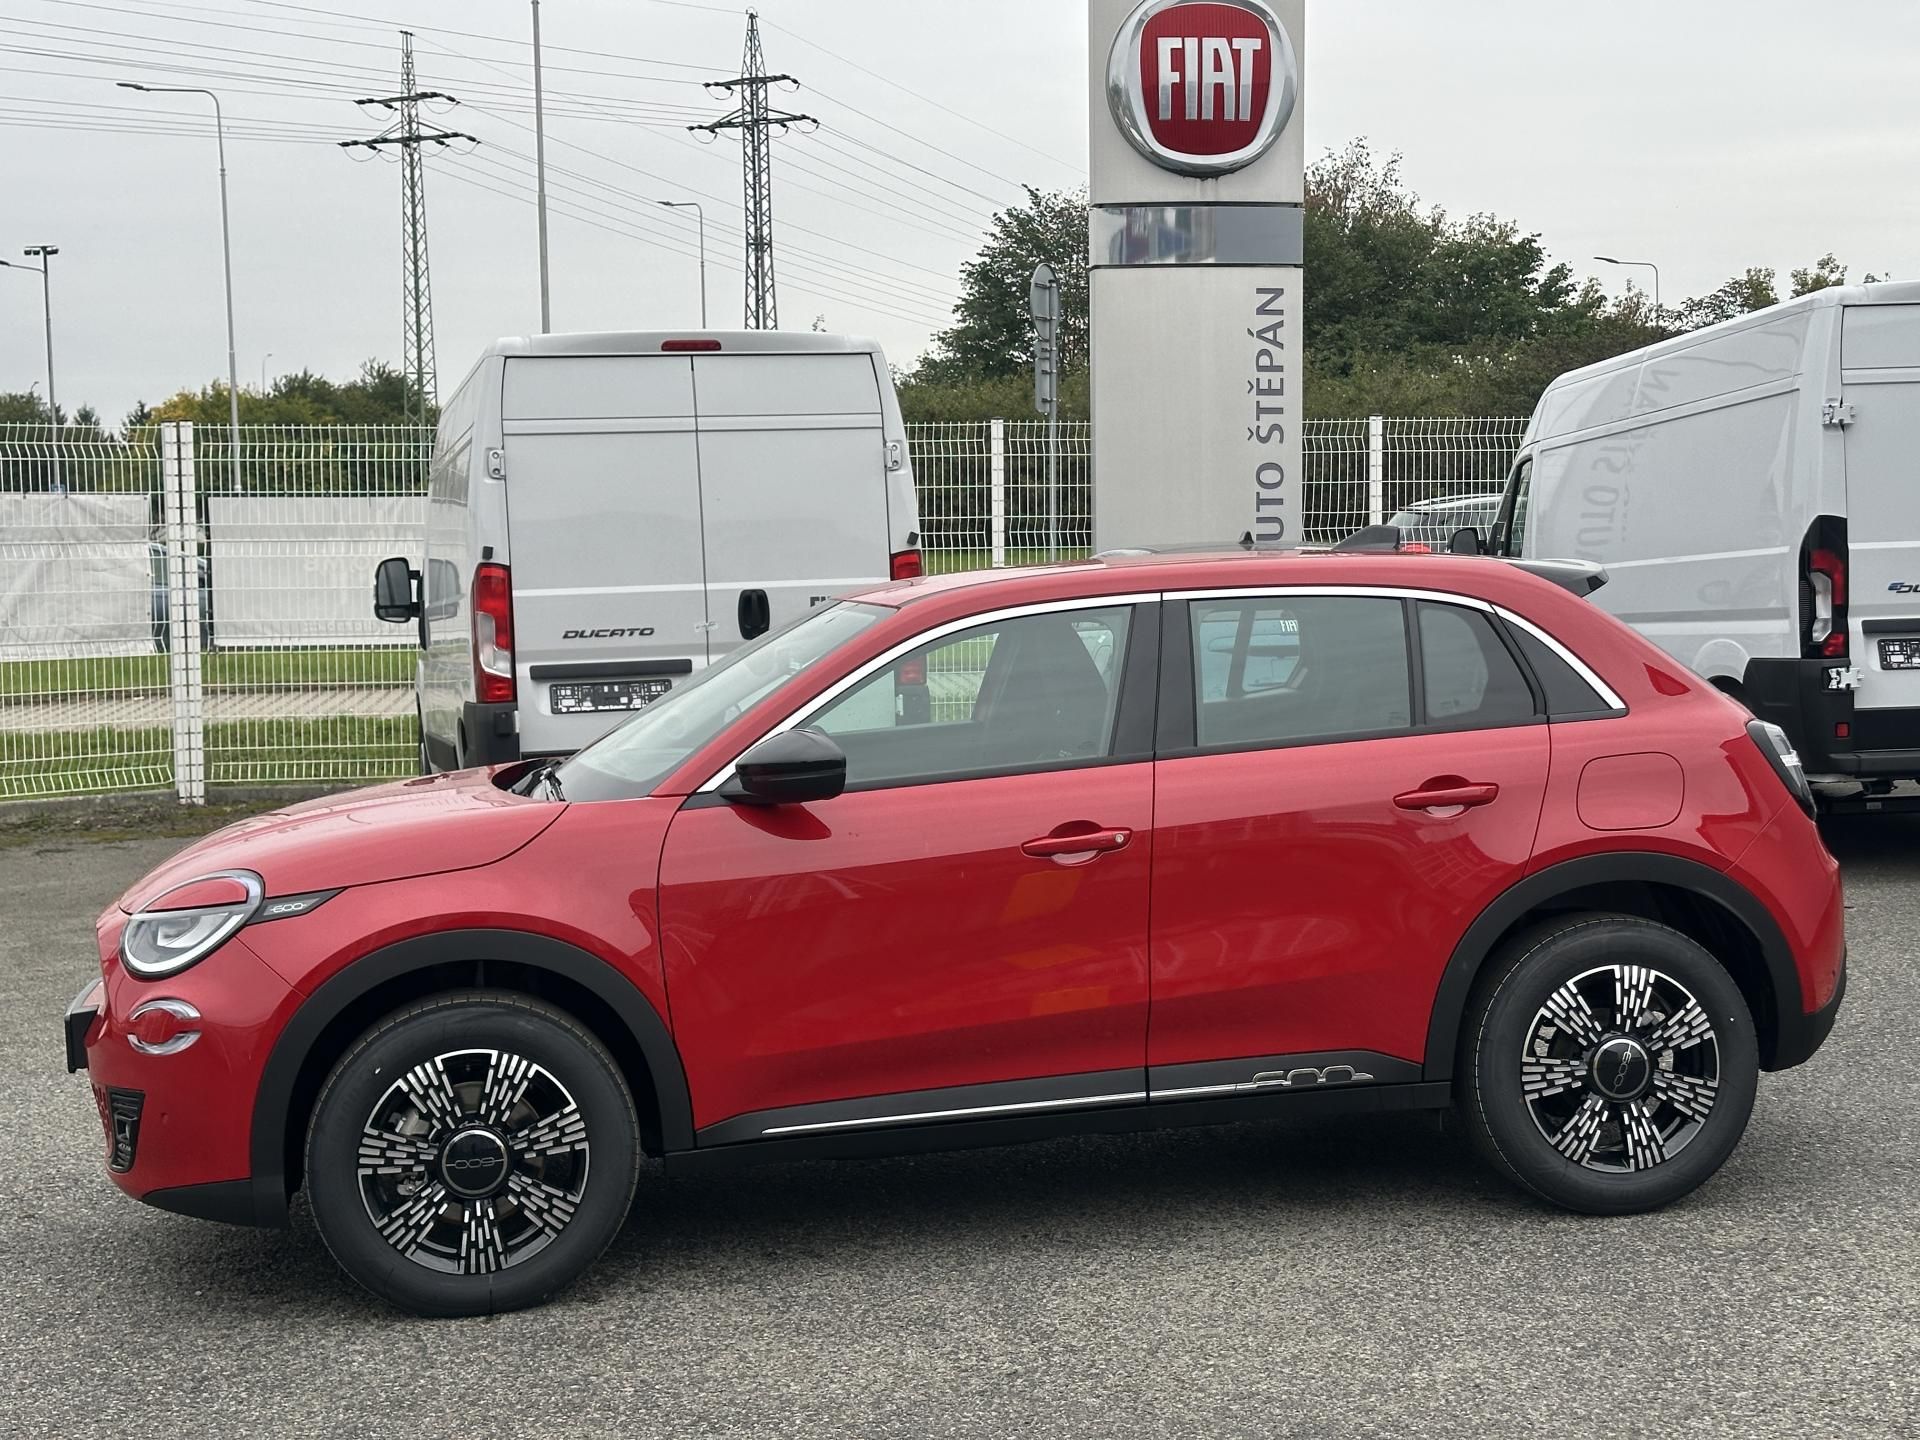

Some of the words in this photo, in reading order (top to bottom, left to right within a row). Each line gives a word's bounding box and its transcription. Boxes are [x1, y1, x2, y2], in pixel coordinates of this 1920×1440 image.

[1157, 37, 1262, 121] FIAT
[1247, 287, 1285, 444] ŠTĚPÁN
[1255, 462, 1285, 542] UTO
[562, 627, 655, 639] DUCATO
[271, 902, 306, 914] 600
